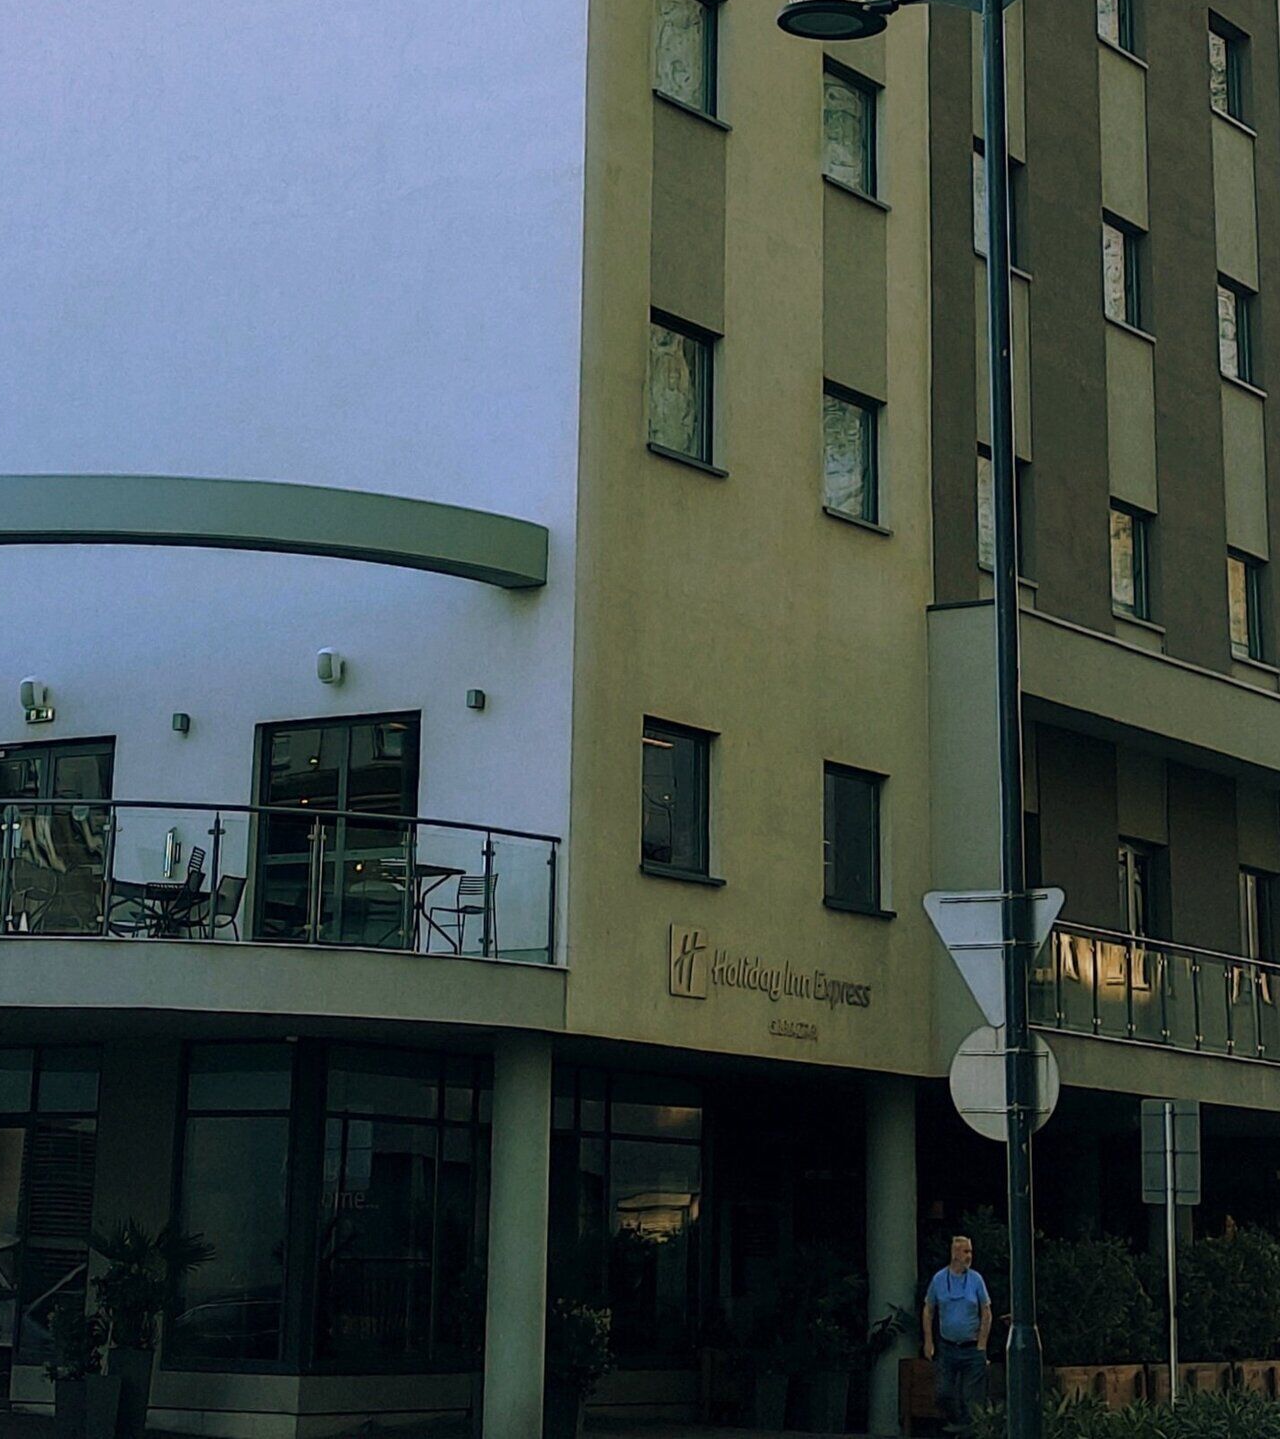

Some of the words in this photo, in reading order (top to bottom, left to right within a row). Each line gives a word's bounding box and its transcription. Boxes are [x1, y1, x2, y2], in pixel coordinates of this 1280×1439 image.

[712, 948, 780, 1001] Holiday
[784, 960, 811, 999] Inn
[813, 969, 871, 1009] Express
